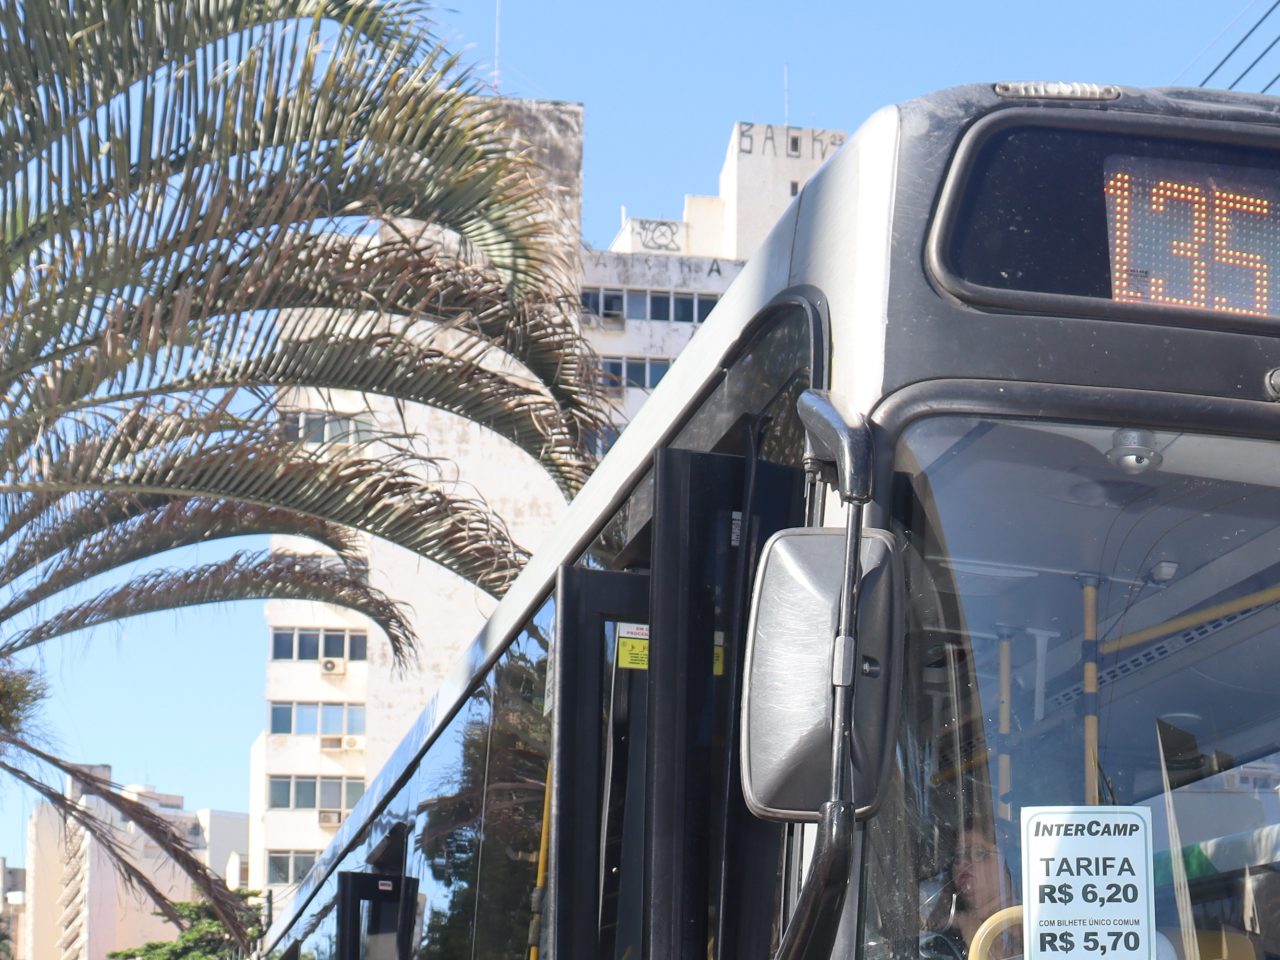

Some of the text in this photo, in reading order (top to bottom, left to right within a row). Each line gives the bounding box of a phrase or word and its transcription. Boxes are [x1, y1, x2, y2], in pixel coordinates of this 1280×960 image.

[1104, 172, 1269, 316] 135
[1040, 857, 1136, 877] TARIFA
[1038, 883, 1139, 908] R$ 6,20
[1039, 919, 1055, 927] COM
[1057, 919, 1087, 927] BILHETE
[1088, 917, 1112, 926] ÚNICO
[1039, 930, 1140, 956] R$ 5,70
